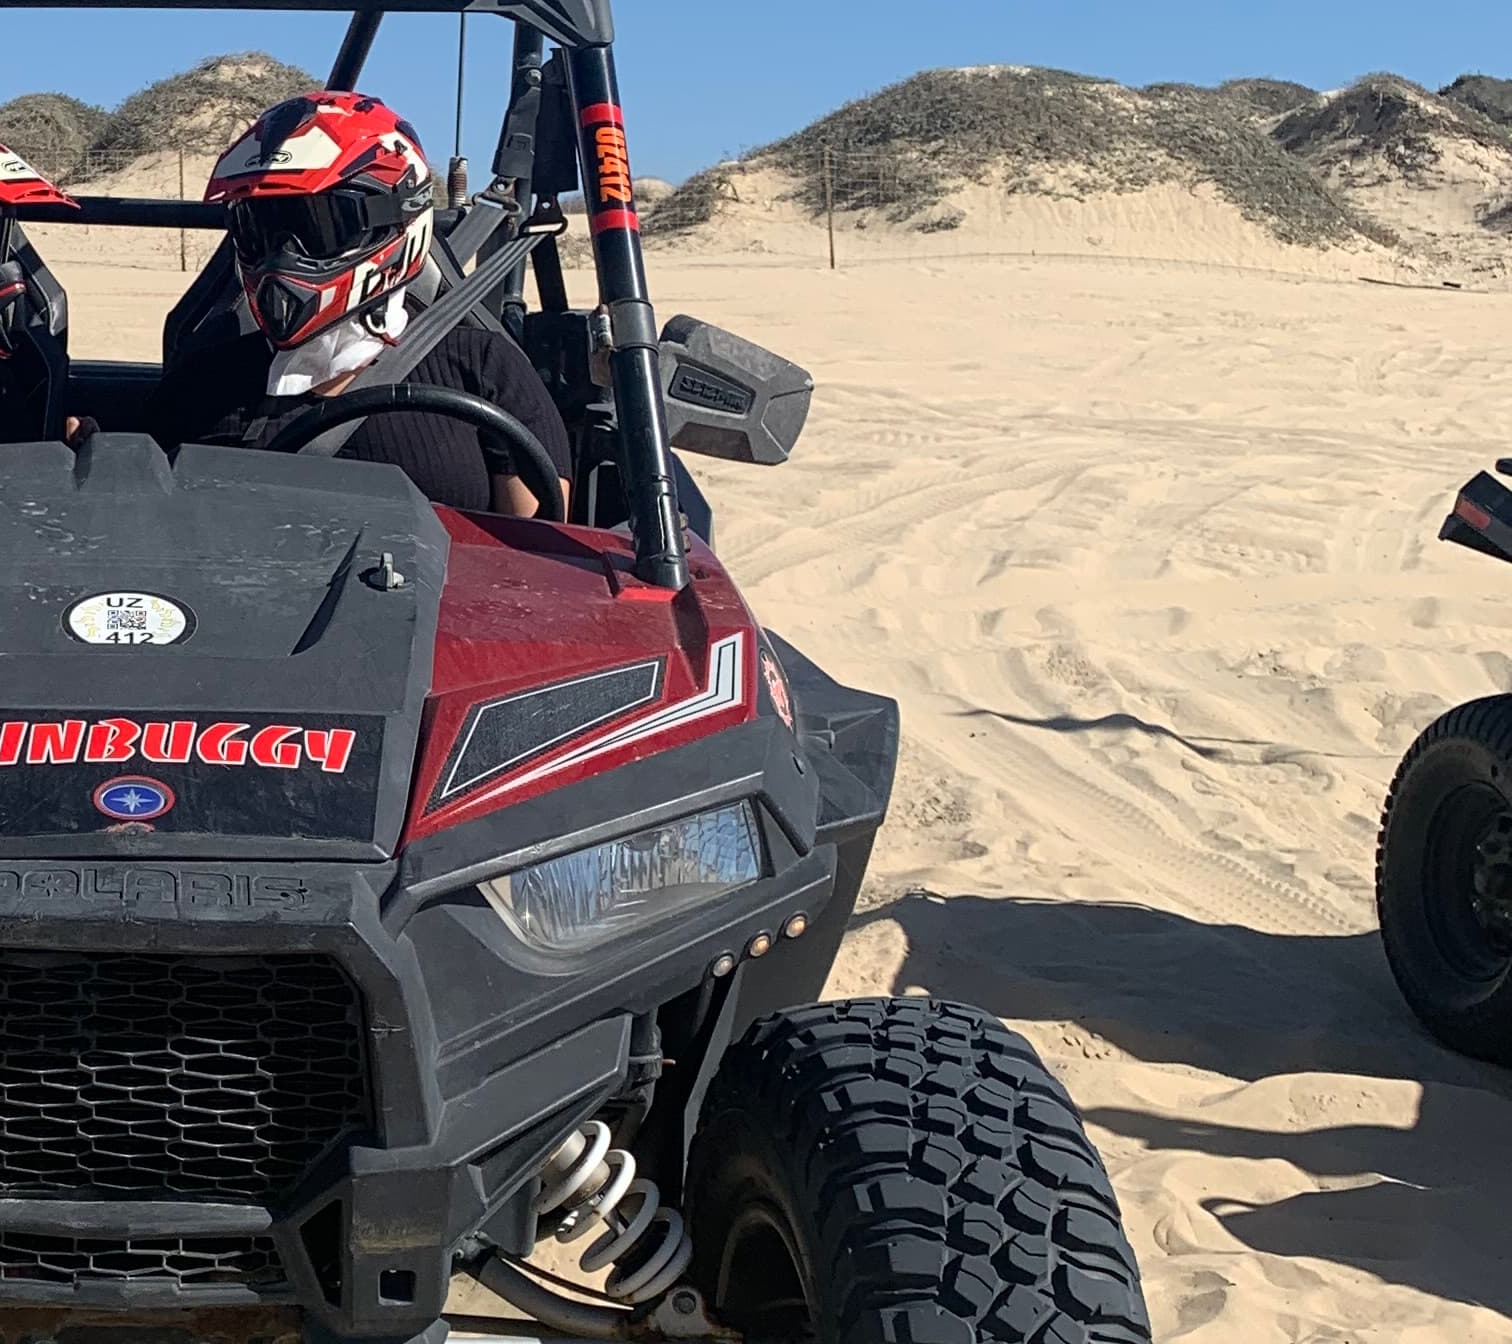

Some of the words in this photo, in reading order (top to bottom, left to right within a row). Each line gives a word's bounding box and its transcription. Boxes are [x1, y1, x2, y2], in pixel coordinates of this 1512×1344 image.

[595, 126, 632, 202] UZ412
[106, 597, 144, 609] UZ
[105, 631, 154, 645] 412
